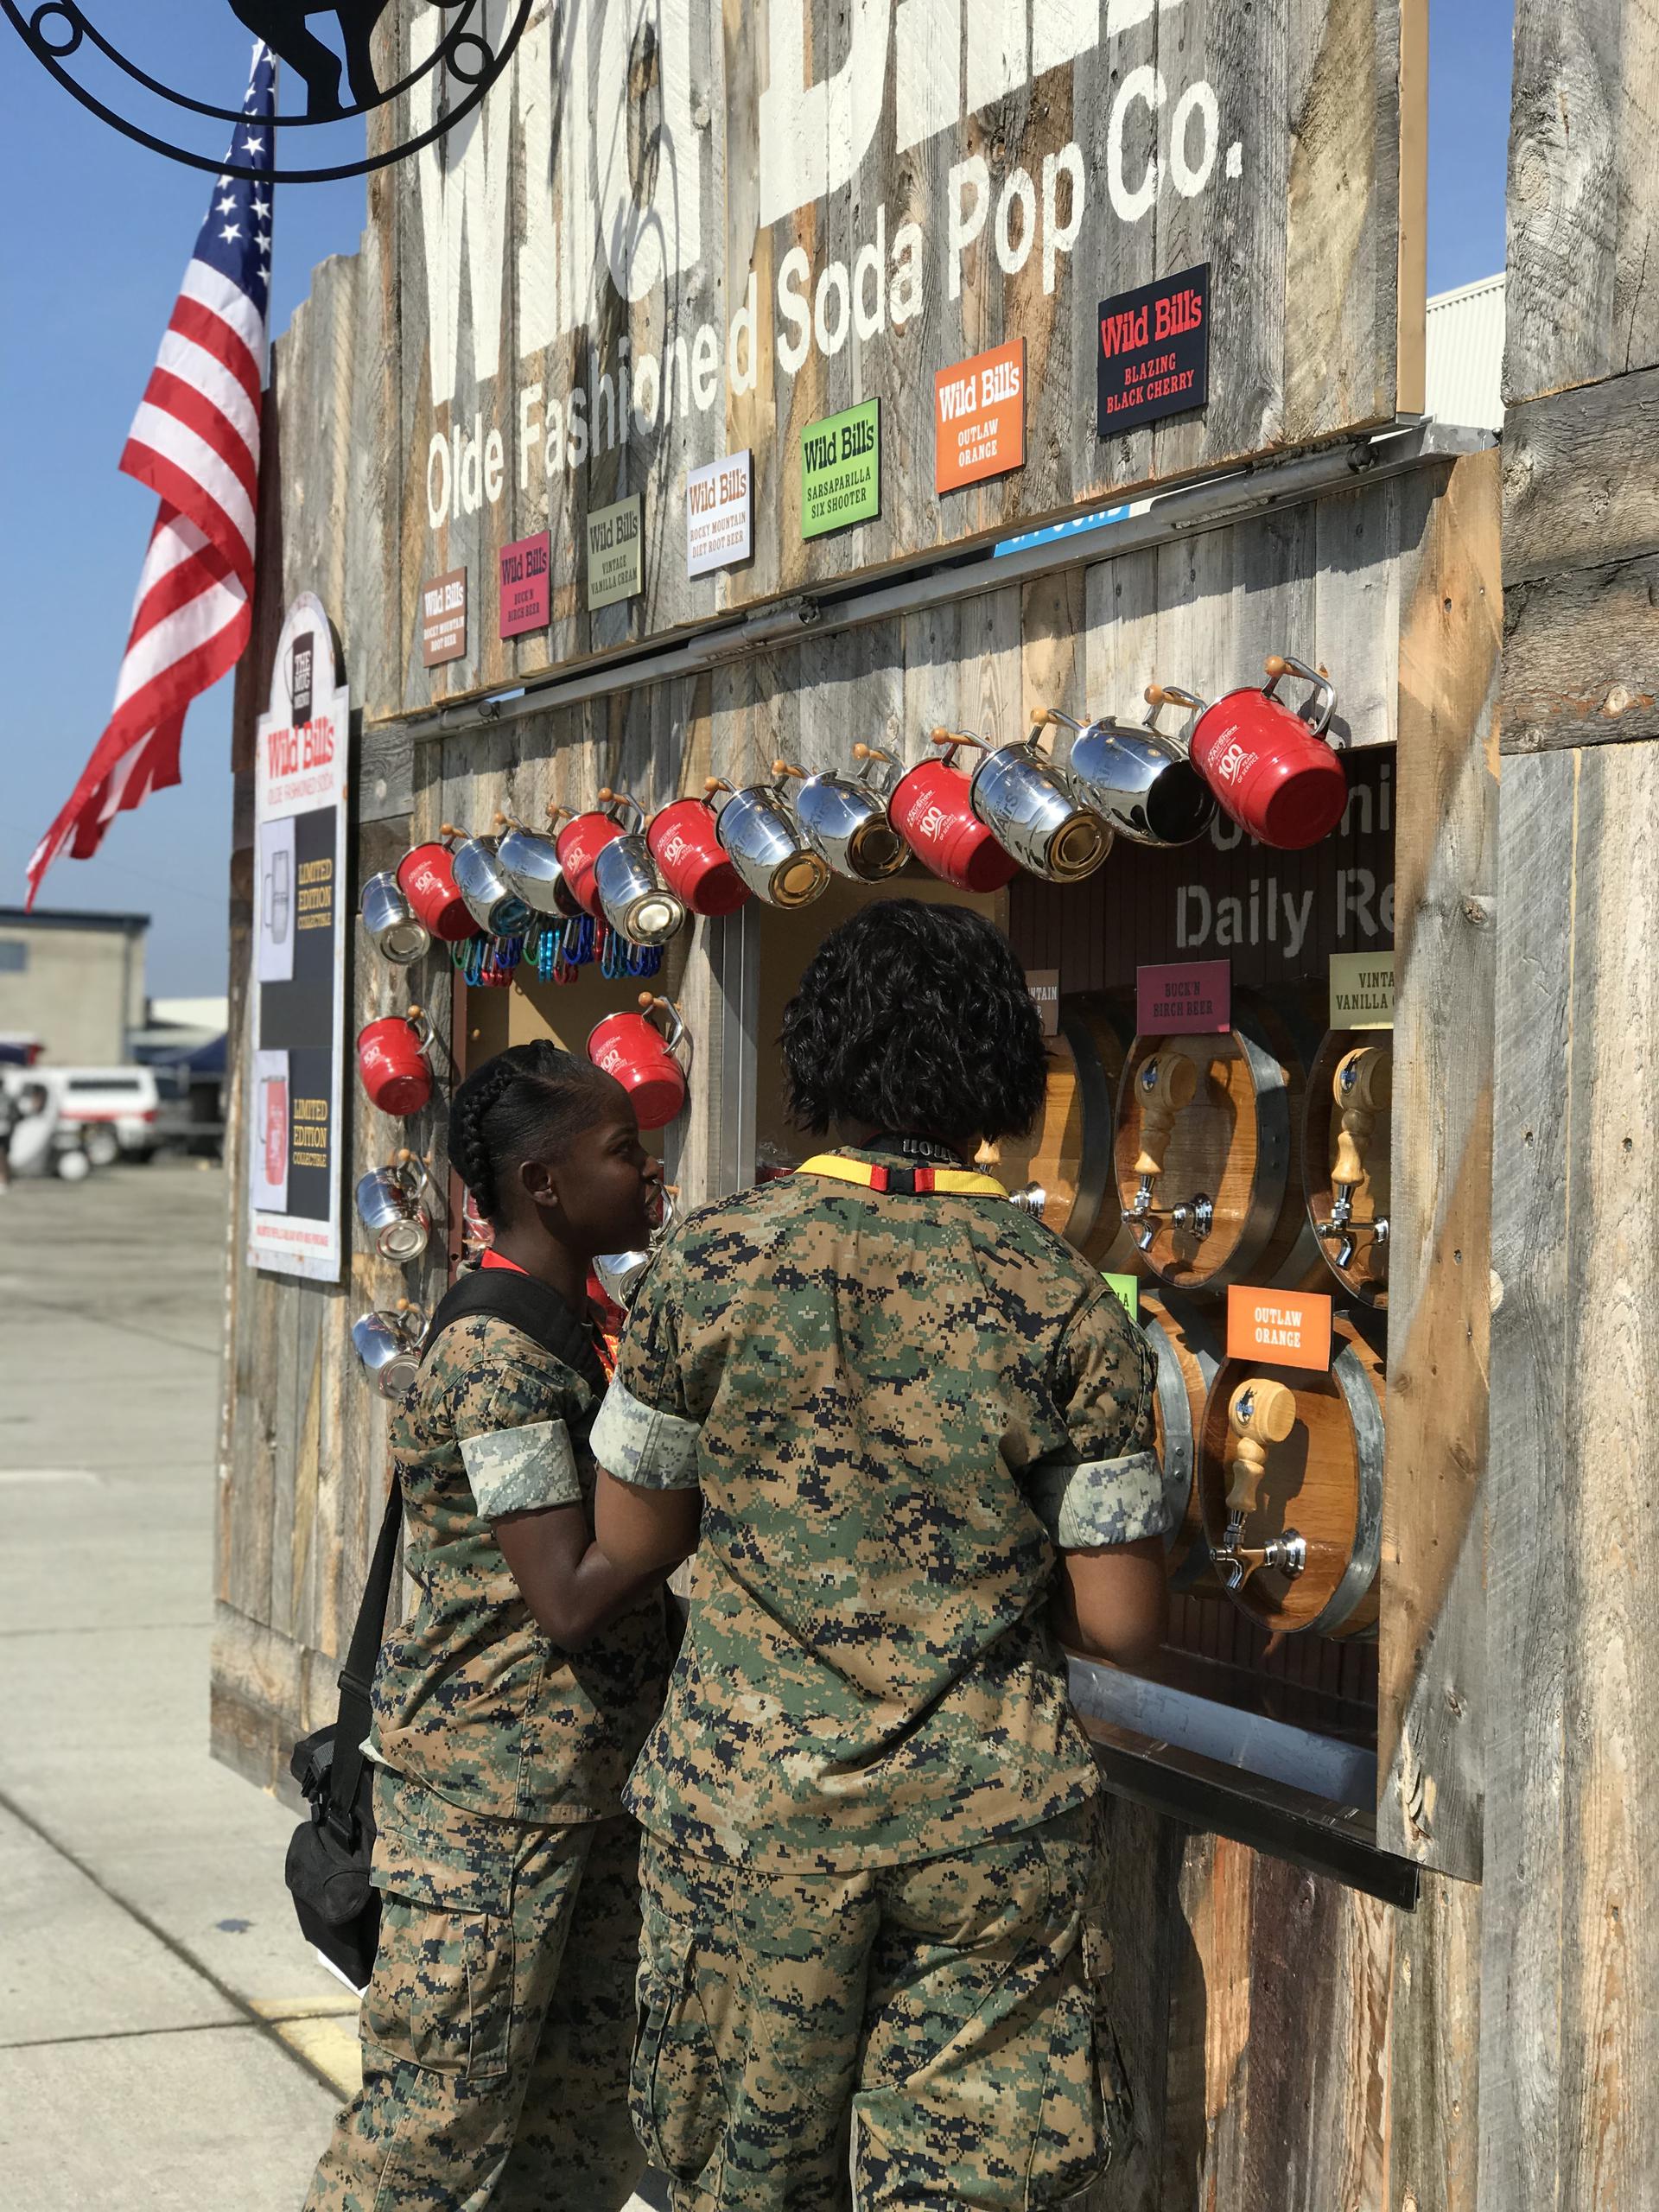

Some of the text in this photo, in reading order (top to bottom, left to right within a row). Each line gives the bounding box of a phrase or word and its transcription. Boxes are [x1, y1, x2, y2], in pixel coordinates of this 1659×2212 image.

[427, 413, 504, 529] Olde
[518, 271, 757, 490] Fashioned
[777, 205, 924, 374] Soda
[948, 141, 1086, 301] Pop
[1107, 65, 1243, 222] Co.
[1101, 289, 1202, 359] Wild Bill's
[1124, 353, 1176, 385] BLAZING
[939, 360, 1020, 423] Wild Bill's
[1107, 370, 1195, 414] BLACK CHERRY
[804, 419, 874, 474] Wild Bill's
[957, 417, 999, 447] OUTLAW
[958, 440, 998, 467] ORANGE
[690, 467, 747, 516] Wild Bill's
[807, 466, 871, 502] SARSAPARILLA
[811, 487, 867, 519] SIX SHOOTER
[589, 510, 638, 555] Wild Bill's
[690, 511, 747, 542] ROCKY MOUNTAIN
[692, 530, 744, 558] DIET ROOT BEER
[501, 546, 547, 586] Wild Bill's
[601, 554, 627, 575] VINTAGE
[591, 567, 638, 595] VANILLA CREAM
[424, 581, 464, 618] Wild Bill's
[268, 725, 299, 780] Wild
[1218, 744, 1243, 780] 100
[1242, 751, 1256, 767] YEARS
[1236, 754, 1260, 784] OF SERVICE
[919, 806, 942, 837] 100
[567, 846, 583, 871] 100
[664, 836, 683, 862] 100
[298, 858, 333, 885] LIMITED
[415, 871, 433, 892] 100
[298, 885, 332, 912] EDITION
[1176, 877, 1314, 958] Daily
[1028, 986, 1058, 1001] NTAIN
[1164, 981, 1200, 999] BUCK'N
[1336, 994, 1389, 1010] VANILLA
[1154, 1000, 1213, 1017] BIRCH BEER
[294, 1098, 328, 1122] LIMITED
[293, 1125, 327, 1148] EDITION
[1255, 1306, 1302, 1327] OUTLAW
[1255, 1327, 1300, 1348] ORANGE
